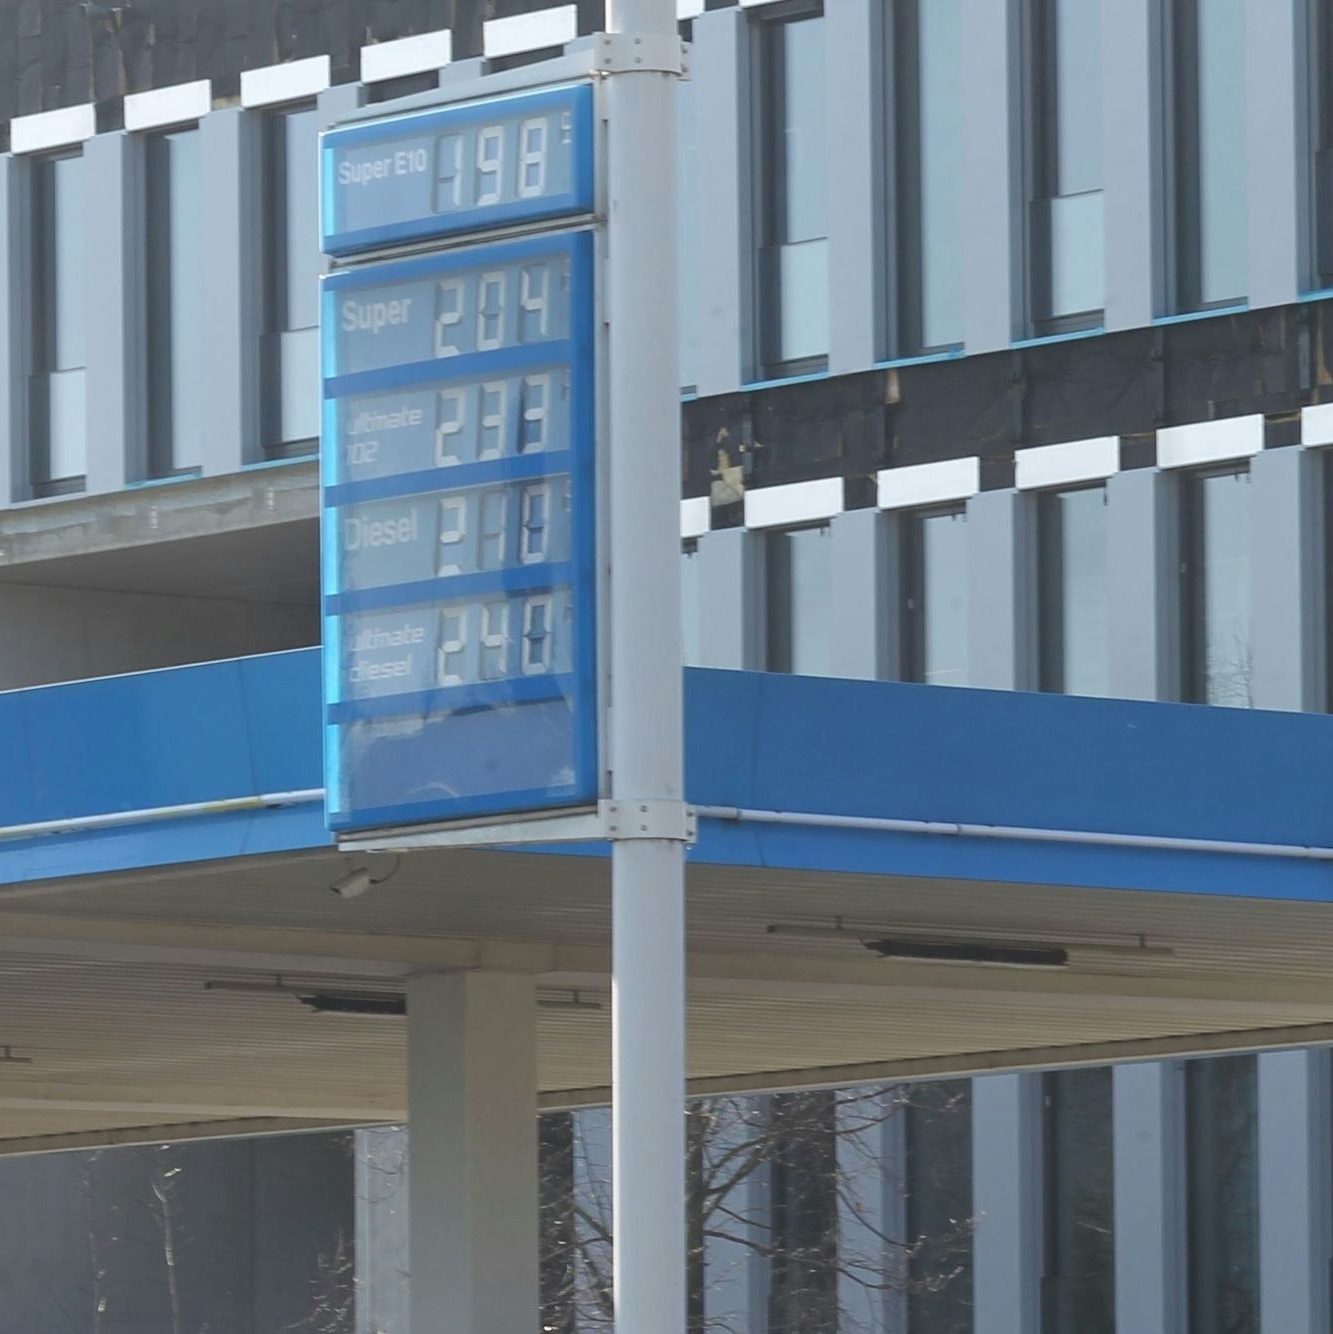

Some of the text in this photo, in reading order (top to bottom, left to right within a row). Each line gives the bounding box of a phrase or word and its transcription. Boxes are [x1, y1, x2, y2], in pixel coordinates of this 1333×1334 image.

[338, 155, 393, 188] Super
[394, 146, 428, 175] E10
[342, 297, 414, 334] Super
[435, 269, 549, 358] 204
[344, 507, 419, 552] Diesel
[436, 594, 553, 687] 240
[349, 653, 413, 683] diesel
